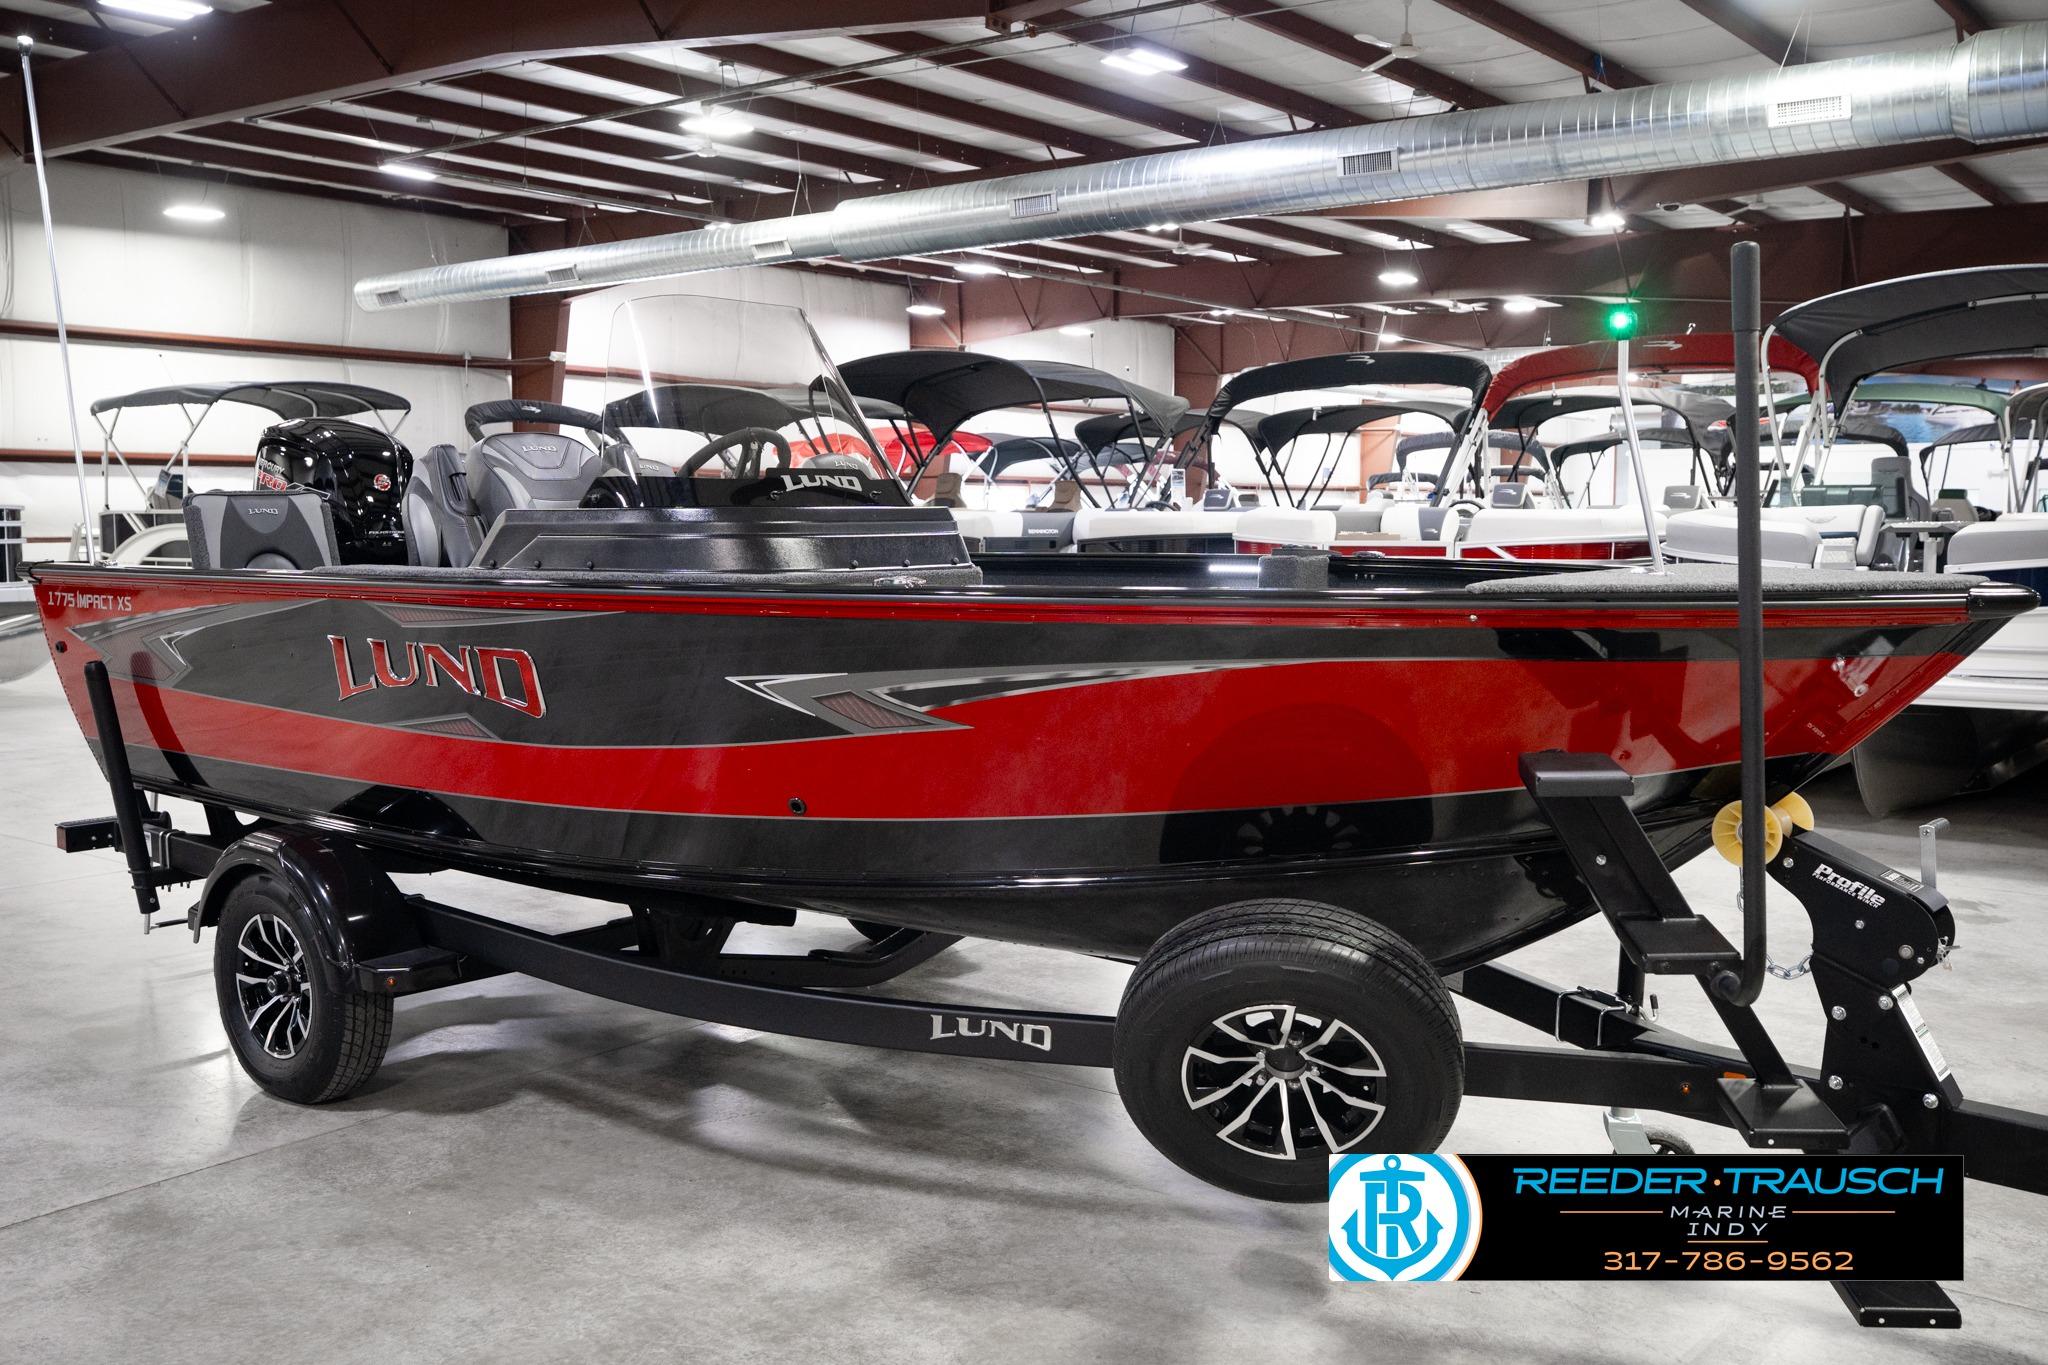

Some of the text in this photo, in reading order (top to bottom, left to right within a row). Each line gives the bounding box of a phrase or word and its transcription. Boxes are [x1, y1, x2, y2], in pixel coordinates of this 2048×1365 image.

[521, 444, 557, 453] LUND
[834, 459, 858, 470] LUND
[780, 474, 863, 492] LUND
[48, 590, 132, 612] 1775 IMPACT XS
[327, 634, 547, 719] LUND
[1811, 872, 1857, 898] PERFORMANCE
[1856, 894, 1880, 909] WINCH
[1813, 863, 1886, 907] Profile
[930, 1014, 1052, 1052] LUND
